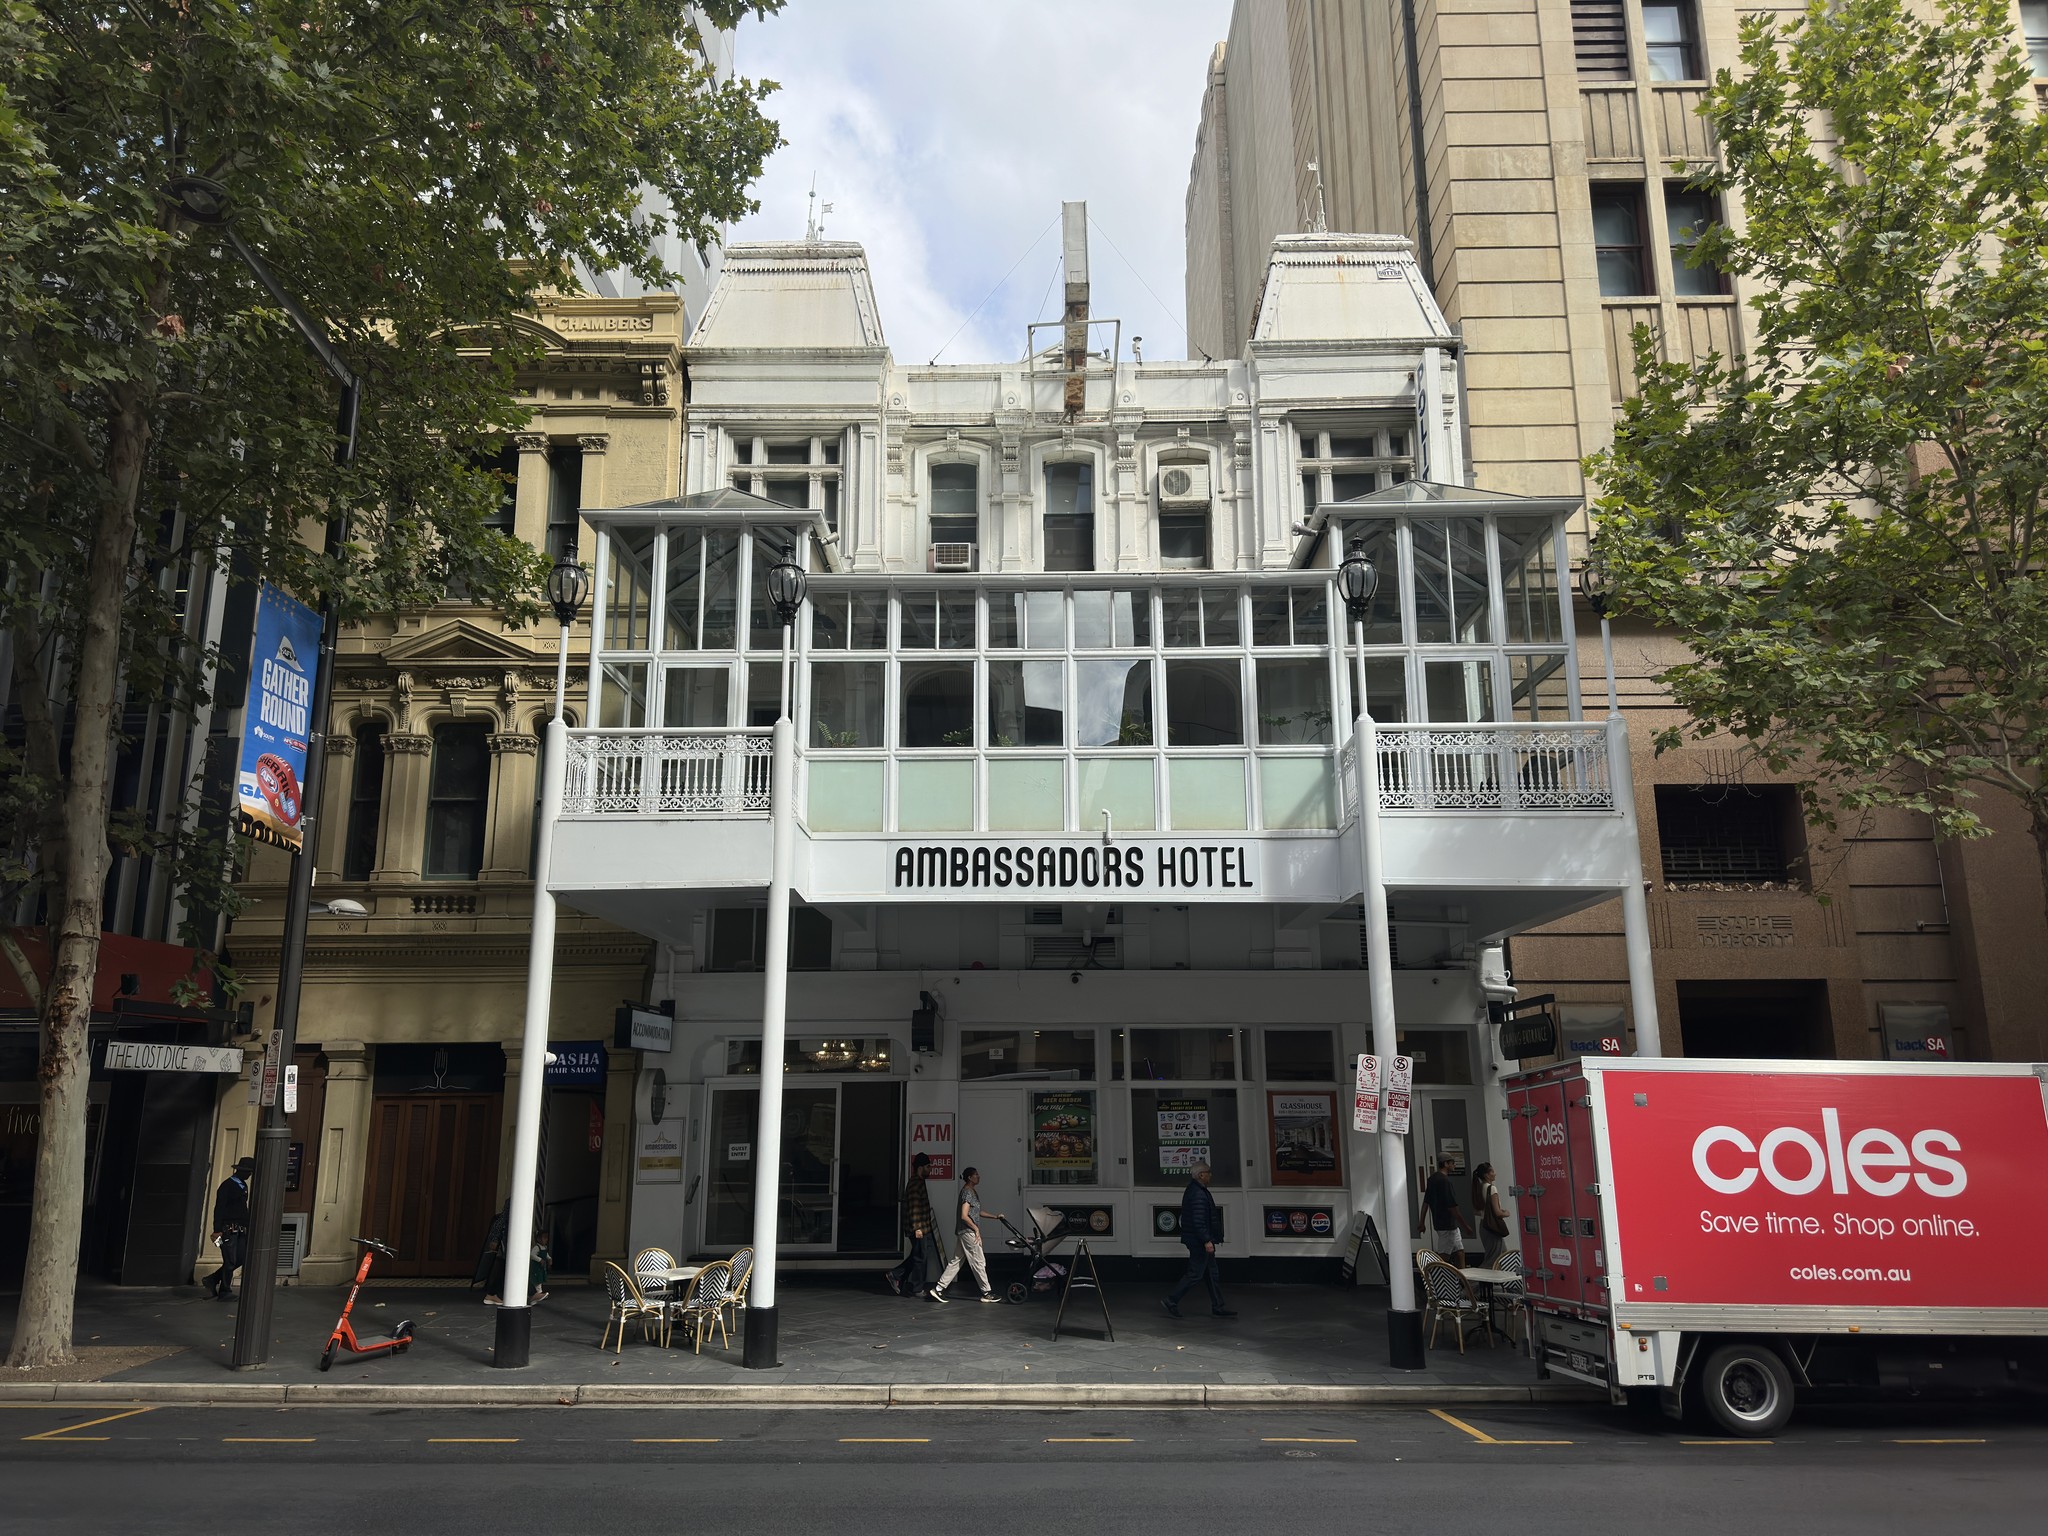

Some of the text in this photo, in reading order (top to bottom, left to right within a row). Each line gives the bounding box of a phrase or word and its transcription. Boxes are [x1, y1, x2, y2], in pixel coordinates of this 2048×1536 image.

[555, 317, 652, 331] CHAMBERS
[262, 658, 308, 707] GATHER
[260, 690, 306, 736] ROUND
[895, 846, 1253, 888] AMBASSADORS HOTEL
[109, 1044, 190, 1069] THE LOST DICE
[549, 1053, 600, 1065] ASHA
[570, 1066, 597, 1074] SALON
[1357, 1094, 1378, 1102] PERMIT
[1359, 1101, 1375, 1109] ZONE
[1388, 1093, 1409, 1102] LOADING
[913, 1124, 950, 1141] ATM
[1534, 1118, 1565, 1147] coles
[1691, 1106, 1968, 1197] coles
[1700, 1210, 1980, 1240] Save time. Shop online.
[1789, 1264, 1911, 1281] coles.com.au
